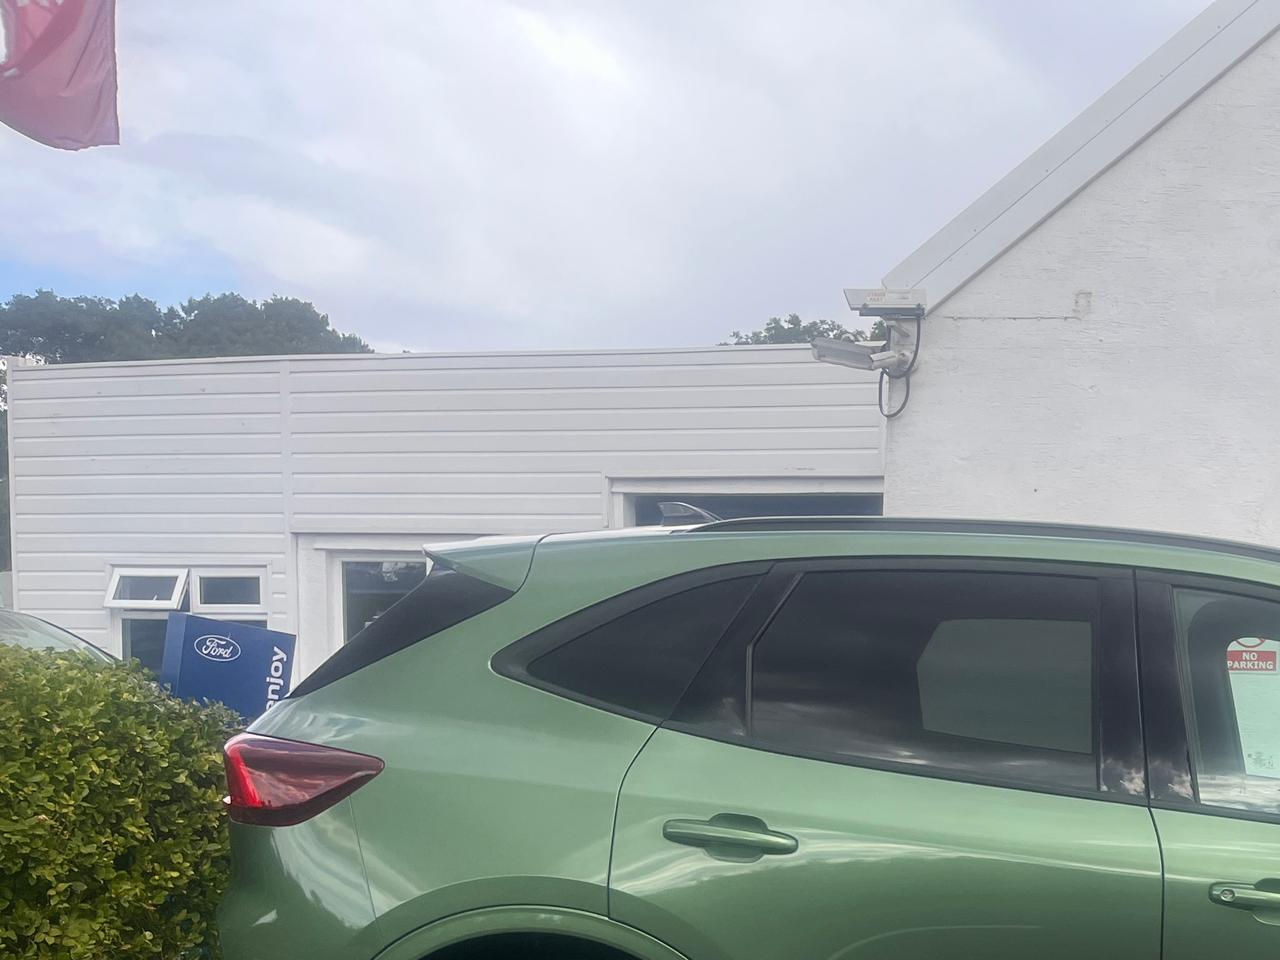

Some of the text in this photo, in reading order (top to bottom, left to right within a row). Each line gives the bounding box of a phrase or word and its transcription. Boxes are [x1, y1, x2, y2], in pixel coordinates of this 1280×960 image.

[203, 638, 233, 658] Ford
[1243, 652, 1258, 660] NO
[1227, 661, 1273, 669] PARKING
